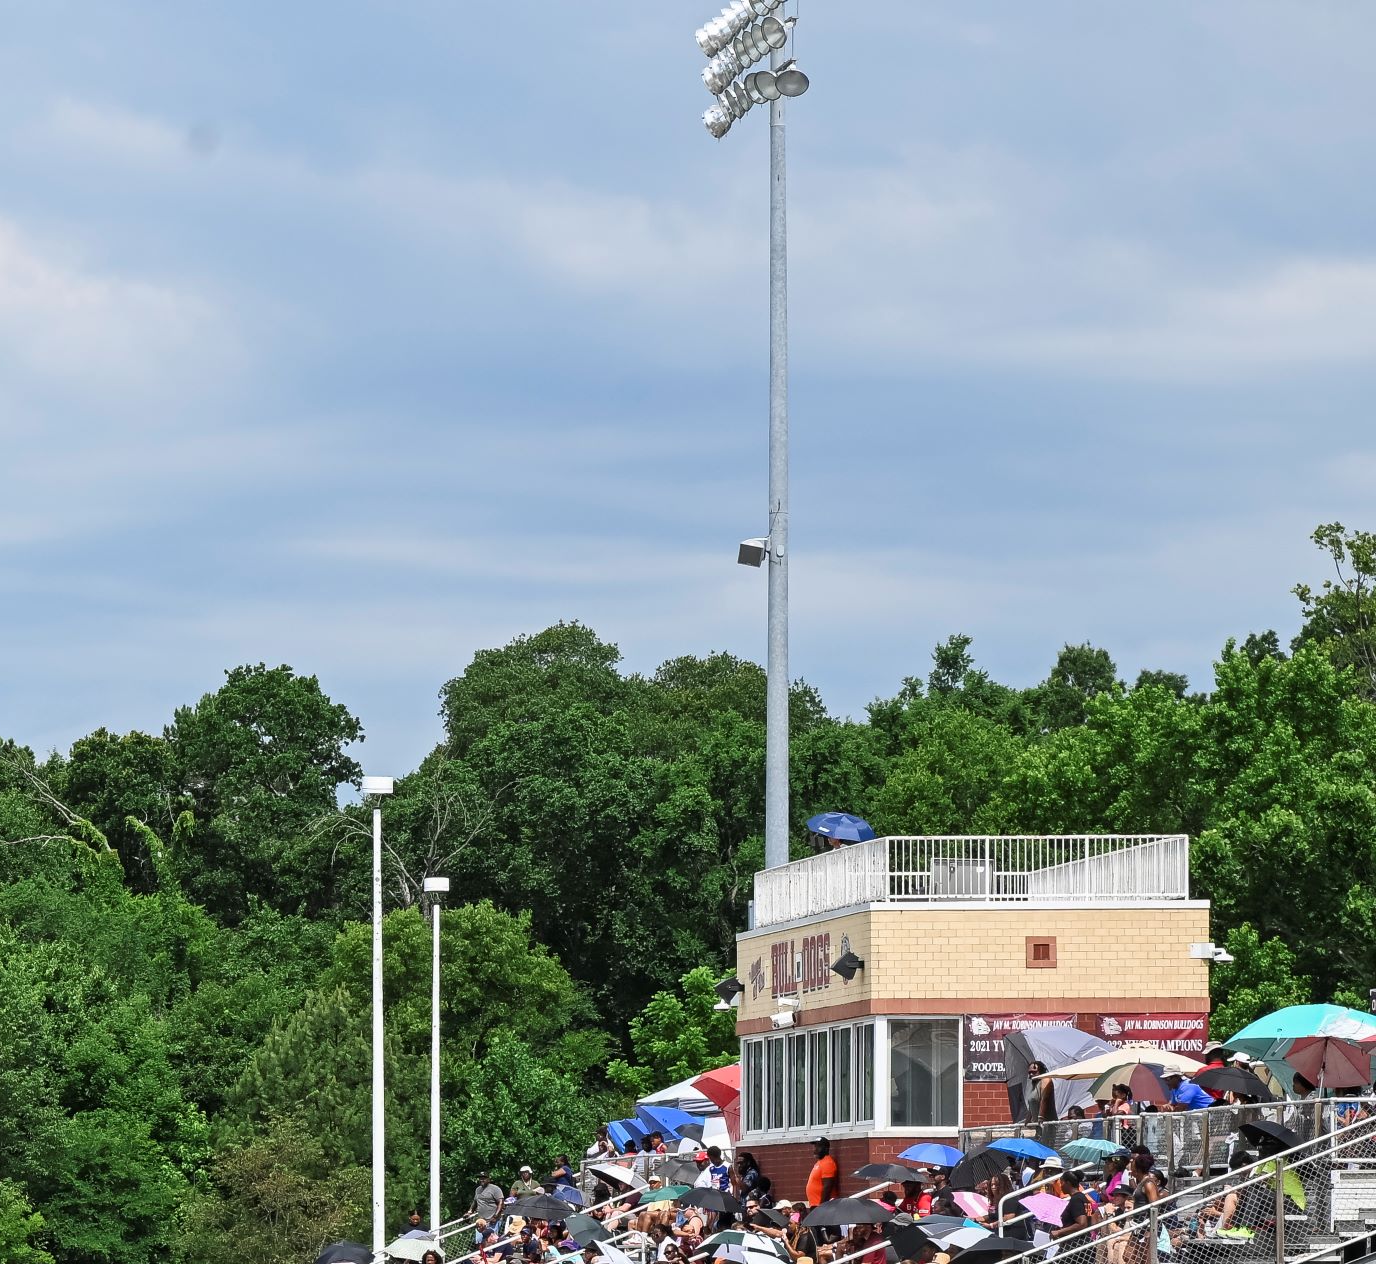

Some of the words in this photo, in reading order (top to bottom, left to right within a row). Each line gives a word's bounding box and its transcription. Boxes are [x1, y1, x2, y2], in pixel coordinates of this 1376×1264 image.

[993, 1020, 1004, 1031] JAY
[1125, 1020, 1135, 1031] JAY
[1144, 1020, 1174, 1030] ROBINSON
[1174, 1020, 1203, 1029] BULLDOGS
[970, 1041, 990, 1051] 2021
[972, 1063, 1005, 1072] FOOTB
